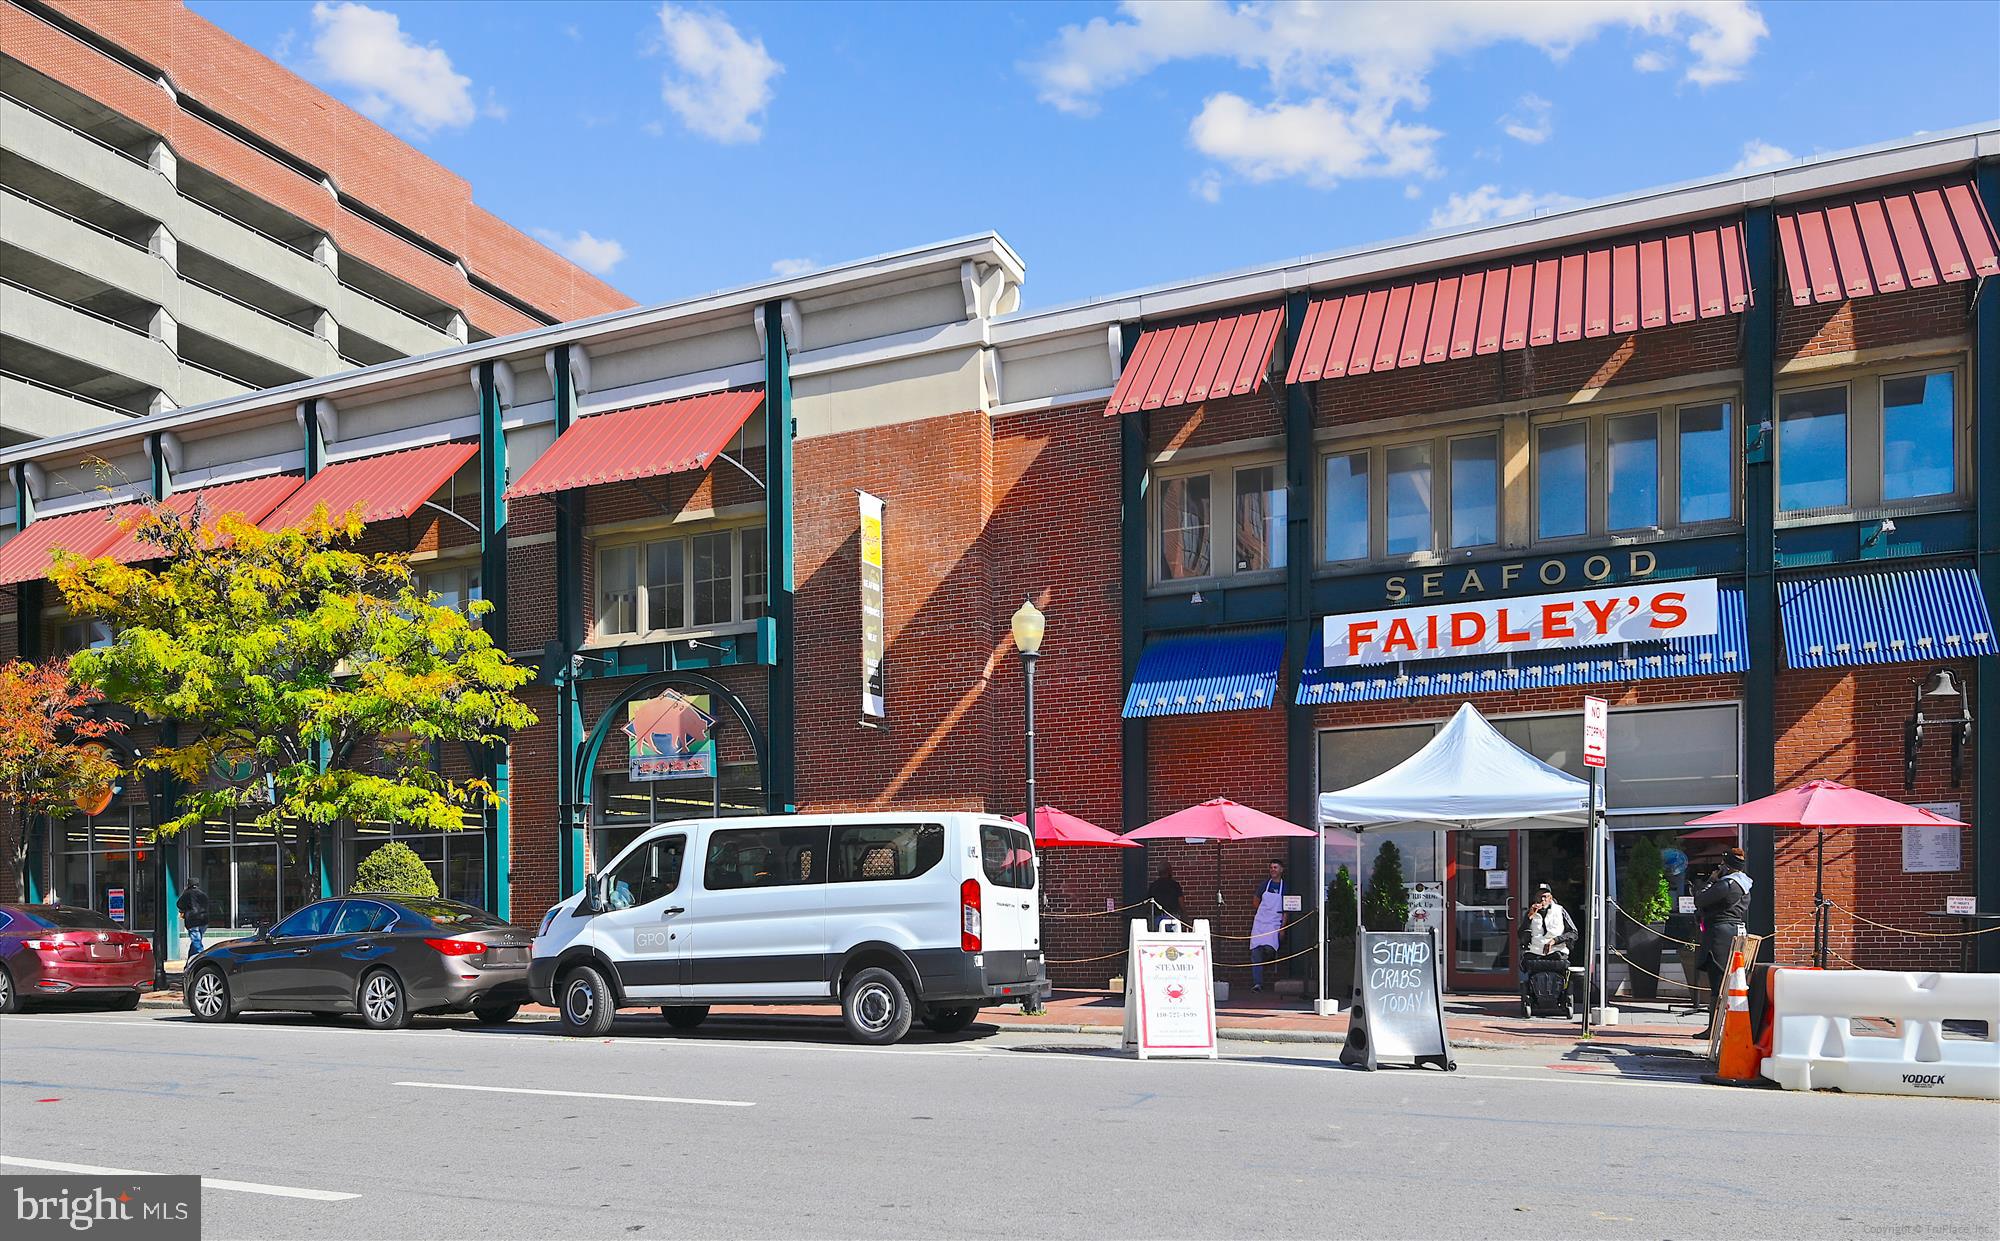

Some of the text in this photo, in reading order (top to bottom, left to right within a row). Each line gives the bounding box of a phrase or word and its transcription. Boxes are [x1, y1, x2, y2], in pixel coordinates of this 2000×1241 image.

[1384, 550, 1658, 602] SEAFOOD
[1347, 592, 1688, 656] FAIDLEY'S
[636, 932, 666, 947] GPO
[1372, 940, 1430, 966] STEAMED
[1155, 963, 1194, 972] STEAMED
[1371, 968, 1422, 990] CRABS
[1902, 1074, 1946, 1084] YODOCK
